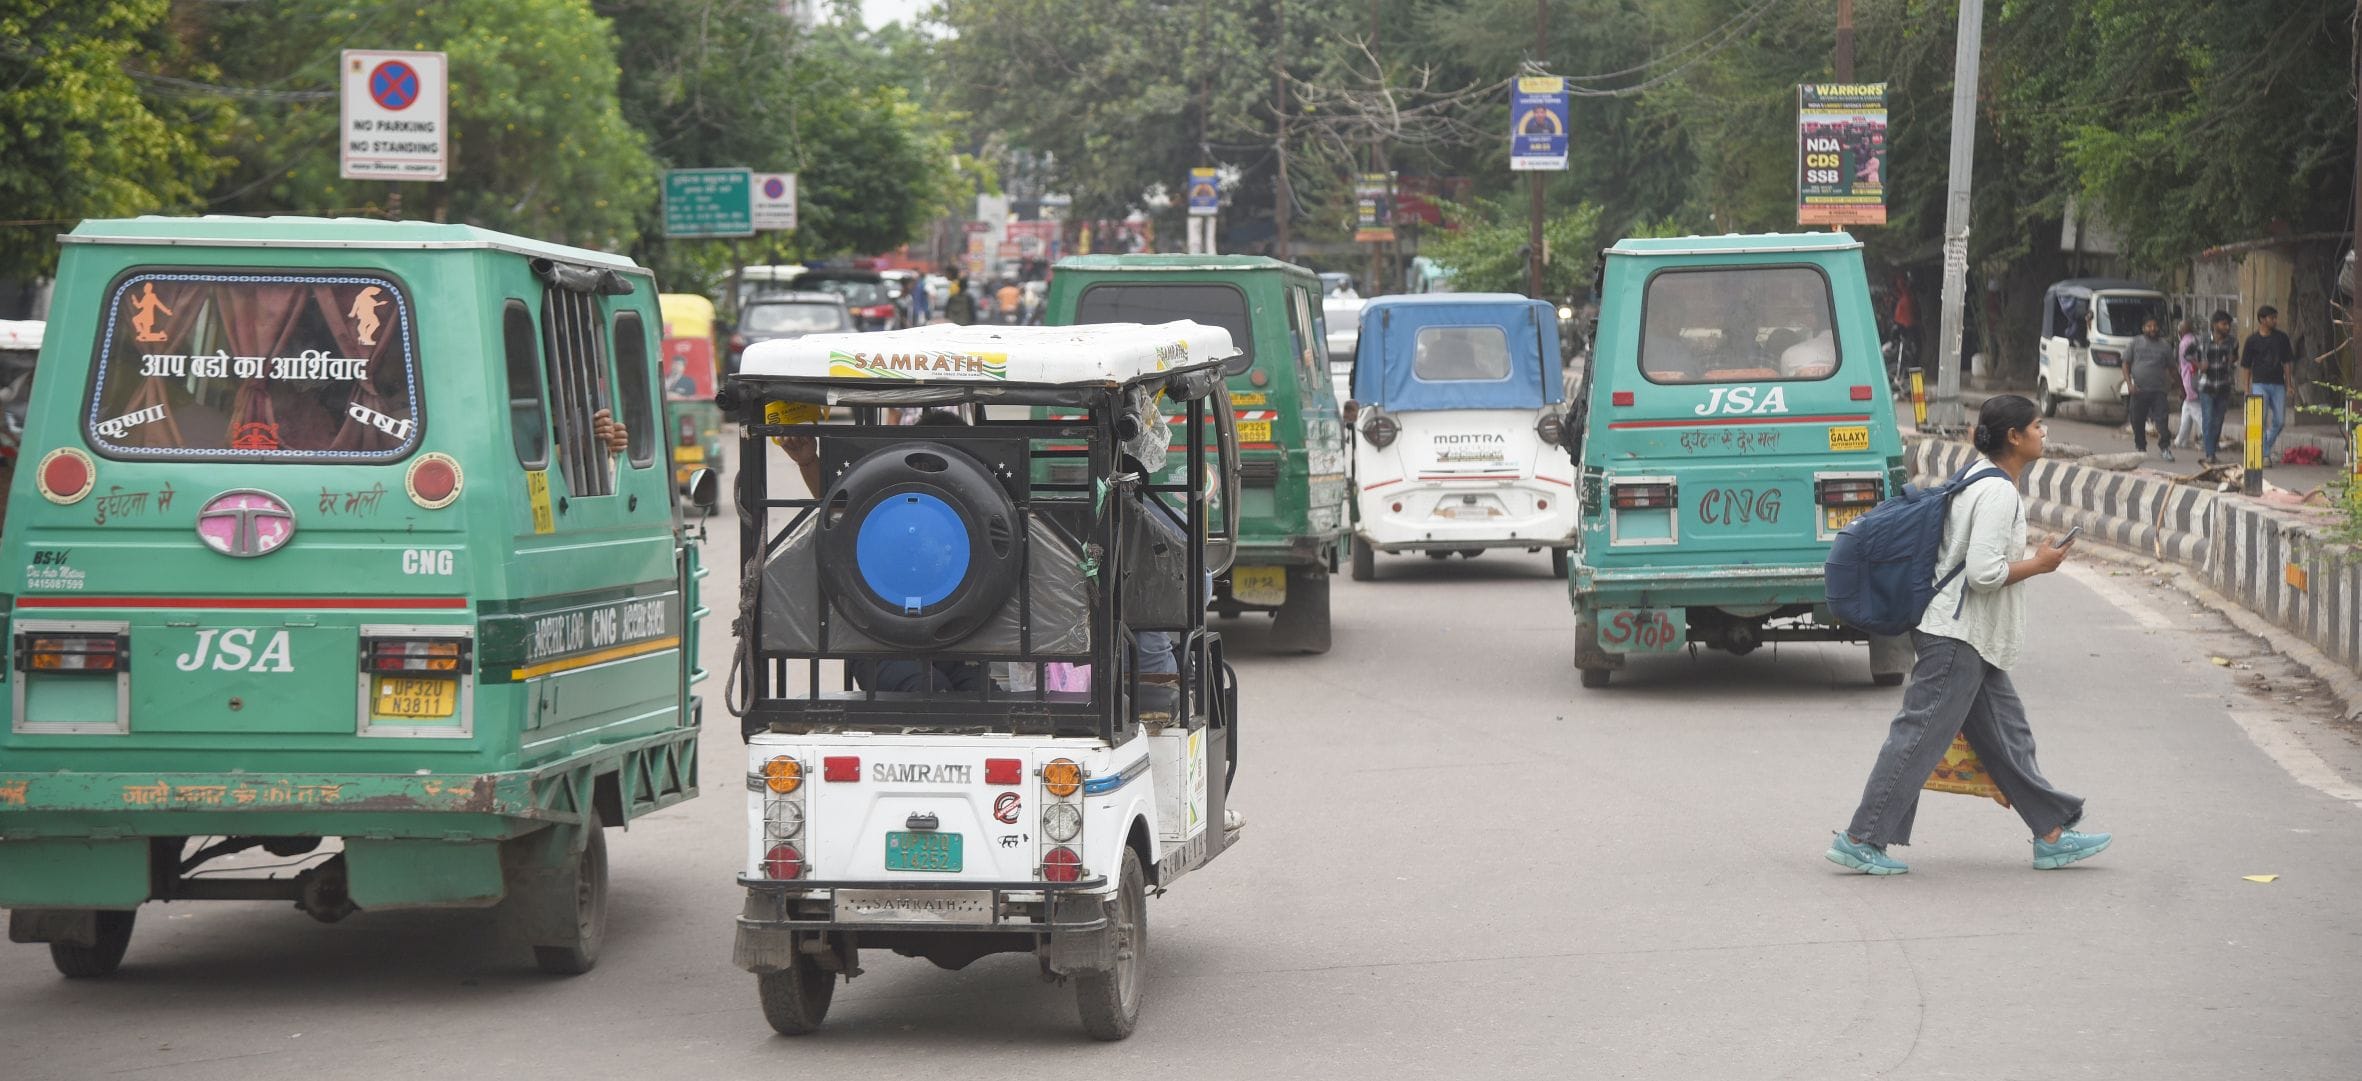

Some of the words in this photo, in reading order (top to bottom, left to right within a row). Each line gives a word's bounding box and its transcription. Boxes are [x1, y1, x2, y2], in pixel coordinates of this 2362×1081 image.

[353, 120, 372, 131] NO
[377, 120, 435, 132] PARKING
[350, 141, 369, 152] NO
[374, 142, 438, 153] STANDING
[1806, 138, 1840, 152] NDA
[1806, 154, 1839, 168] CDS
[1807, 169, 1839, 184] SSB
[140, 354, 187, 378] आप
[233, 356, 266, 380] का
[855, 352, 983, 372] SAMRATH
[1695, 386, 1788, 416] JSA
[96, 403, 168, 439] कृष्णा
[349, 401, 417, 441] वर्षा
[1434, 434, 1505, 444] MONTRA
[1830, 432, 1866, 443] GALAXY
[1699, 488, 1781, 526] CNG
[402, 550, 453, 575] CNG
[592, 608, 616, 647] CNG
[177, 628, 294, 673] JSA
[393, 698, 440, 714] N3811
[872, 763, 972, 784] SAMRATH
[874, 899, 960, 910] SAMRATH
